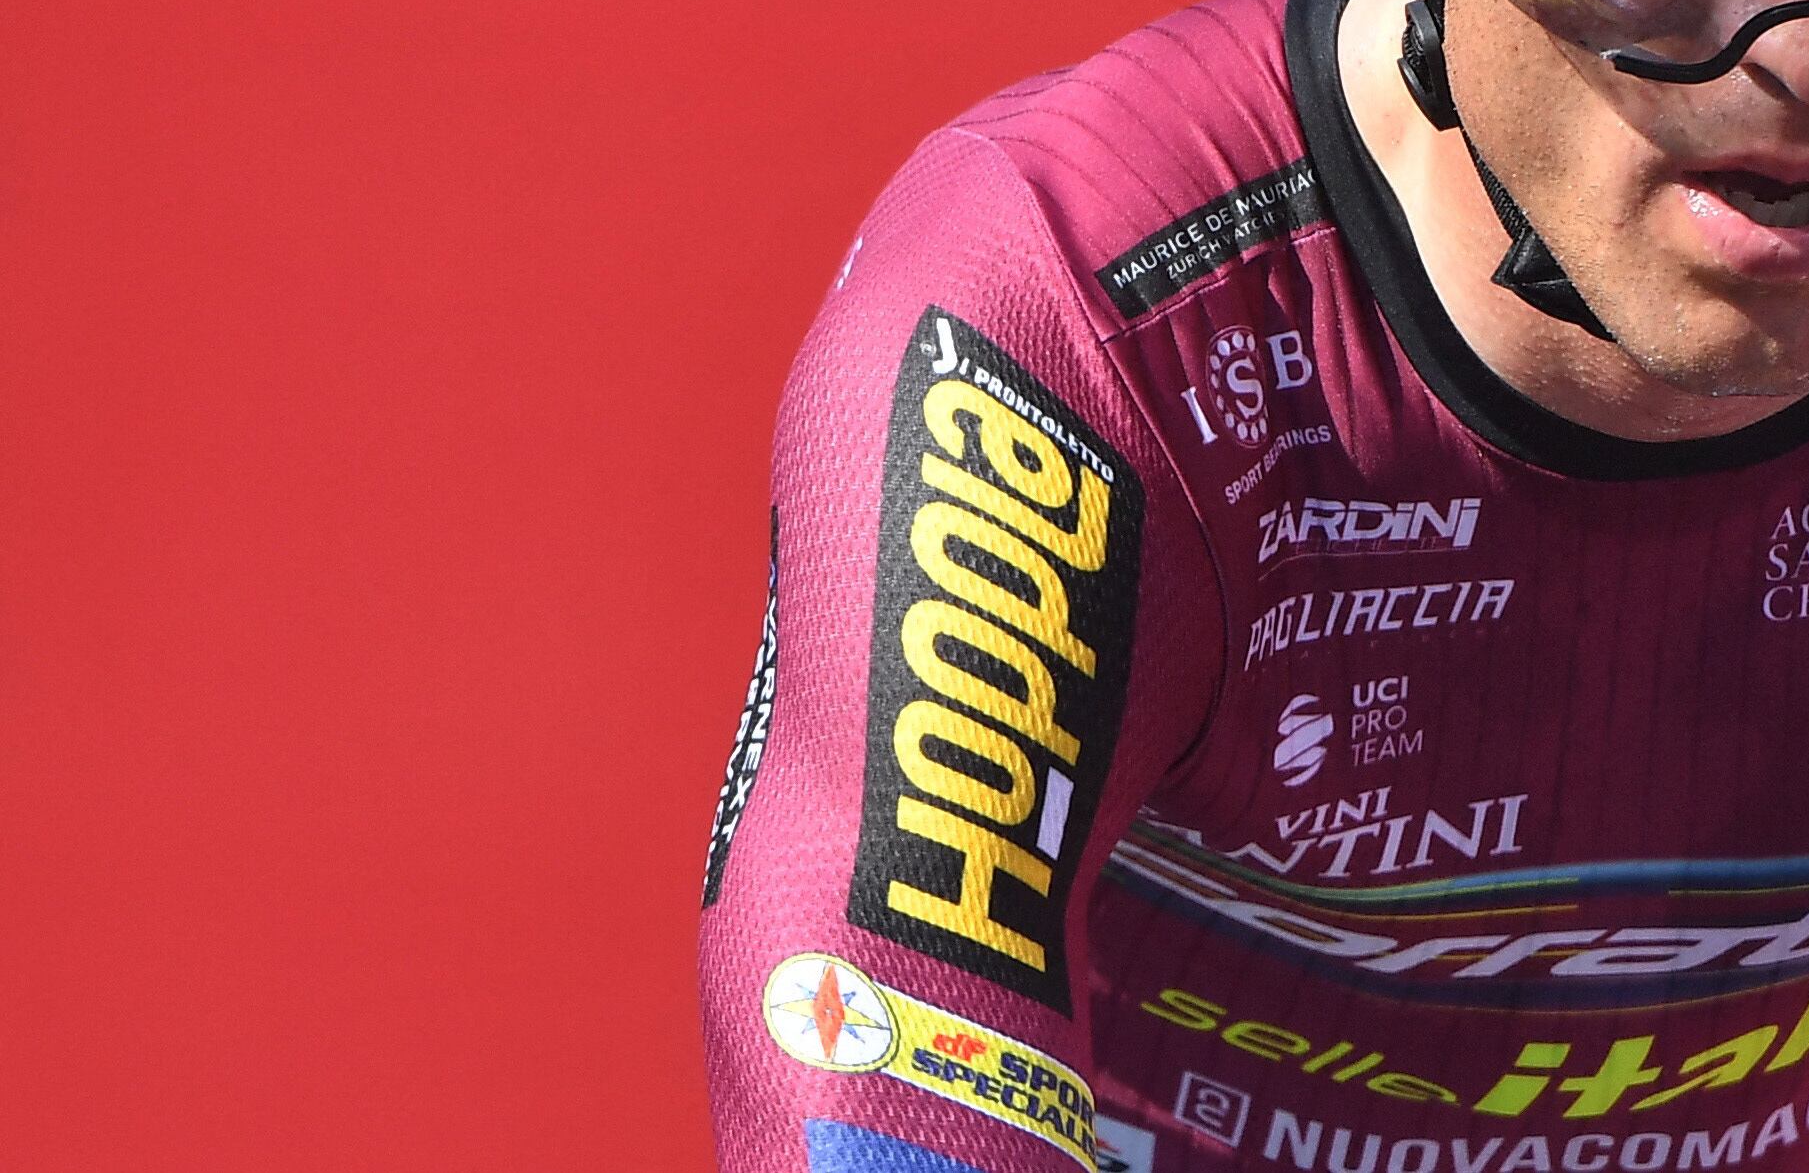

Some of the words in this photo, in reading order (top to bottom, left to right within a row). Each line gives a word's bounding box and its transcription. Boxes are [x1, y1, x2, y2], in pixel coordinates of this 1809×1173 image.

[1112, 222, 1205, 290] MAURICE
[1205, 206, 1235, 233] DE
[1166, 238, 1222, 280] ZURICH
[973, 365, 1115, 483] PRONTOLETTO
[1224, 461, 1264, 506] SPORT
[1243, 578, 1516, 672] PAGLIACCIA
[1352, 675, 1410, 706] UCI
[1352, 705, 1408, 733] PRO
[1352, 729, 1424, 767] TEAM
[1275, 785, 1393, 840] VINI
[1140, 987, 1461, 1108] selle
[999, 1051, 1096, 1127] SPOR
